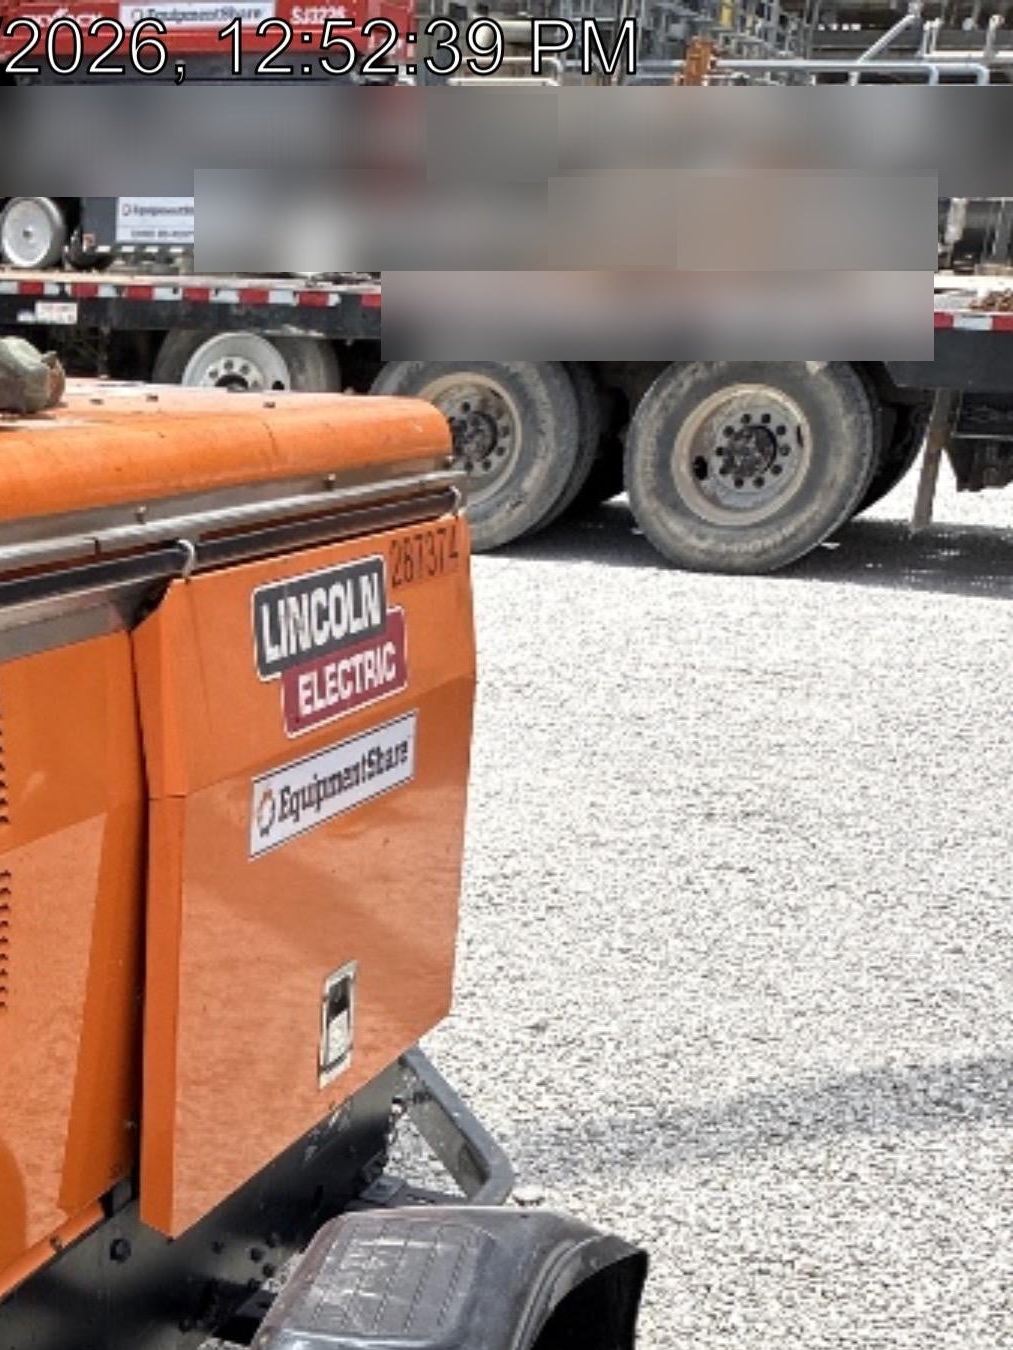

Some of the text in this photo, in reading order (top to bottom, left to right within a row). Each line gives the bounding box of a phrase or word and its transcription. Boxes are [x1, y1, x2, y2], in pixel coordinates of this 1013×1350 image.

[261, 571, 382, 664] LINCOLN
[297, 640, 397, 716] ELECTRIC
[278, 739, 409, 823] EquipmentShare
